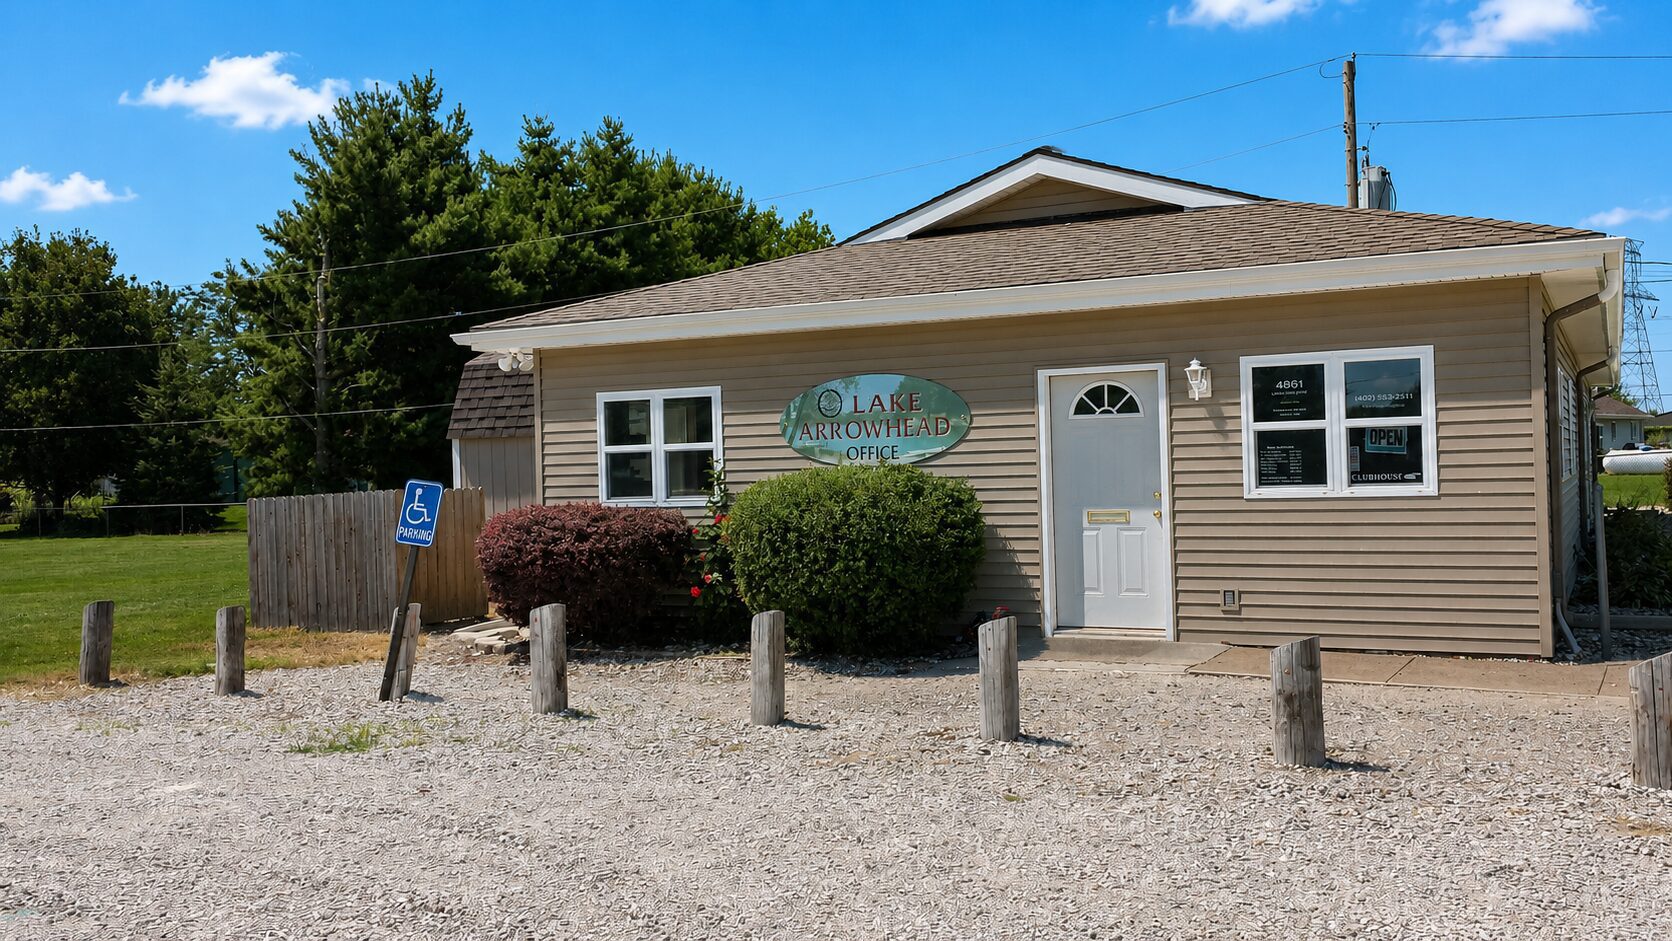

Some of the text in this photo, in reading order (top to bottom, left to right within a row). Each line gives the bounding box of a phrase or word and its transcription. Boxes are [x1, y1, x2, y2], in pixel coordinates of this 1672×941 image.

[1275, 380, 1303, 389] 4861
[853, 393, 922, 414] LAKE
[799, 416, 951, 441] ARROWHEAD
[1370, 428, 1404, 446] OPEN
[846, 445, 899, 461] OFFICE
[399, 526, 432, 542] PARKING
